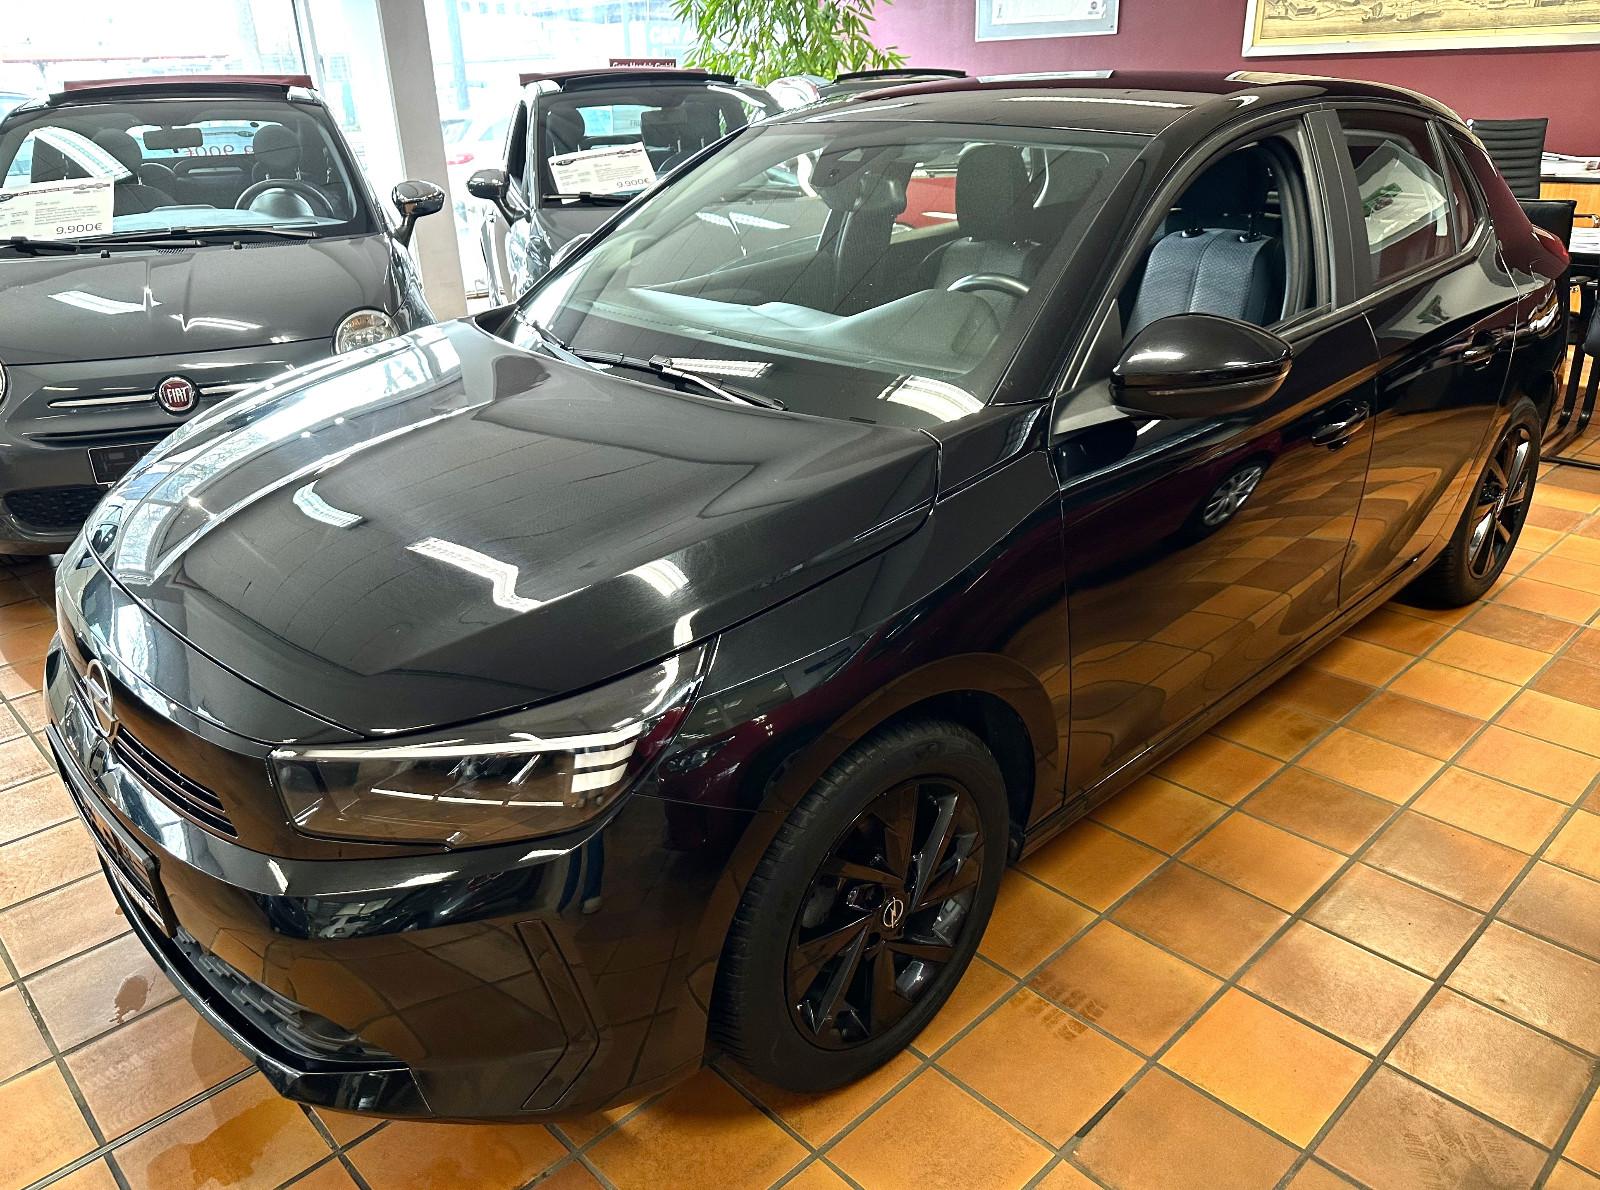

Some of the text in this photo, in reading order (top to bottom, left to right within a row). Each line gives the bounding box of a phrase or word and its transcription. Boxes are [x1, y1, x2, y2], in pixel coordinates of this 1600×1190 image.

[616, 177, 649, 188] 9.900€
[56, 222, 103, 235] 9.900€
[167, 386, 189, 404] FIAT
